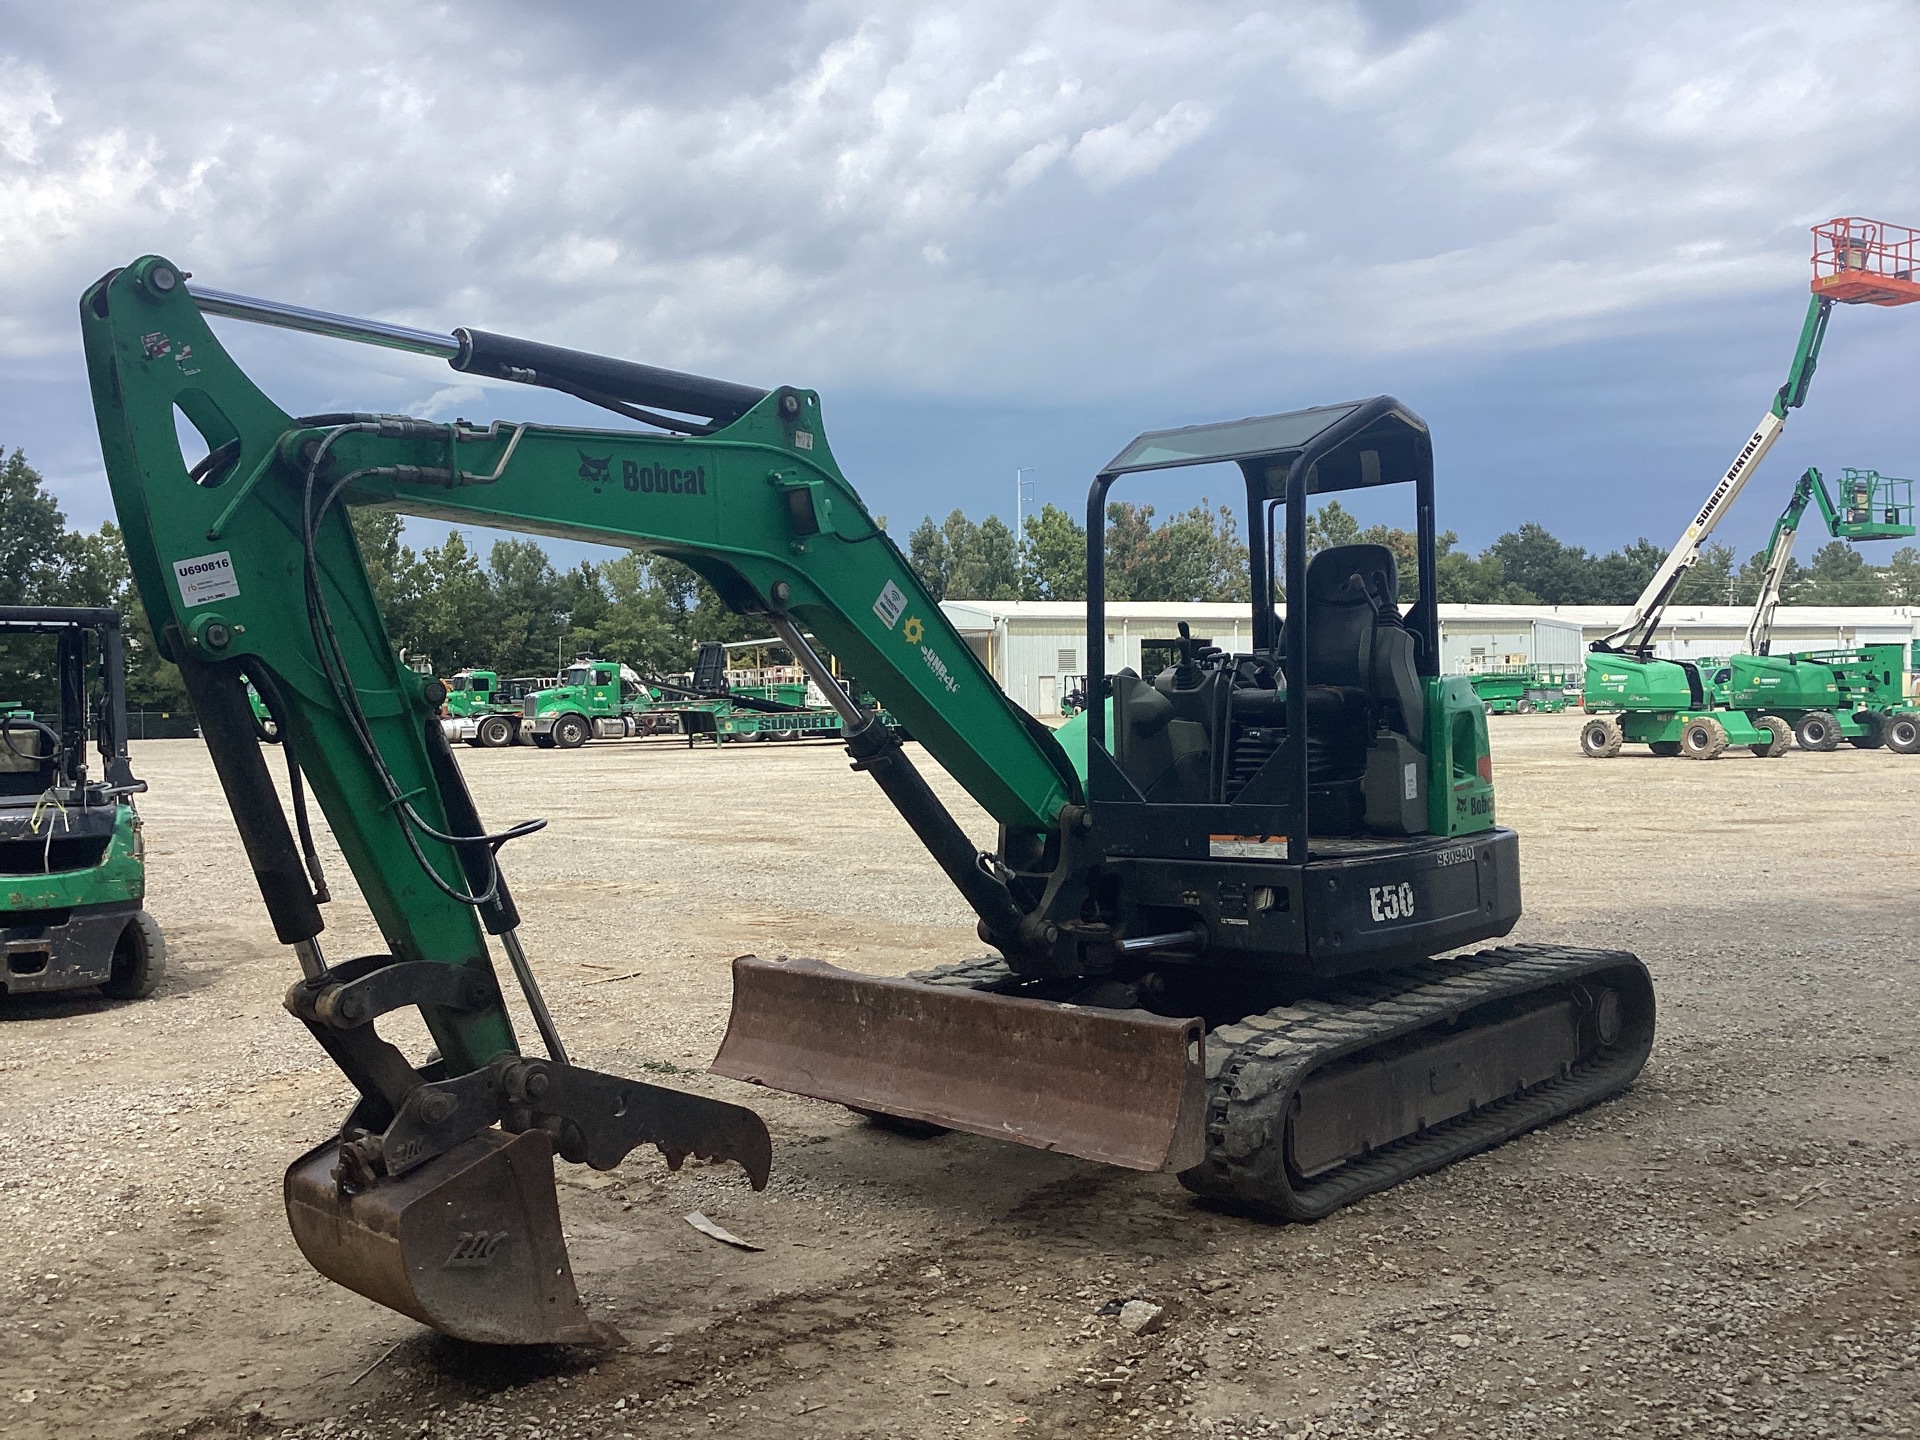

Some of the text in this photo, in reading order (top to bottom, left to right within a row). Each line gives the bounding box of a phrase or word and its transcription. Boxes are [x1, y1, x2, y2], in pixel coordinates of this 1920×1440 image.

[622, 460, 706, 495] Bobcat
[1696, 432, 1763, 527] SUNBELT RENTALS
[179, 559, 229, 577] U690816
[758, 716, 838, 730] SUNBELT
[1437, 846, 1474, 865] 930940
[1369, 881, 1415, 922] E50
